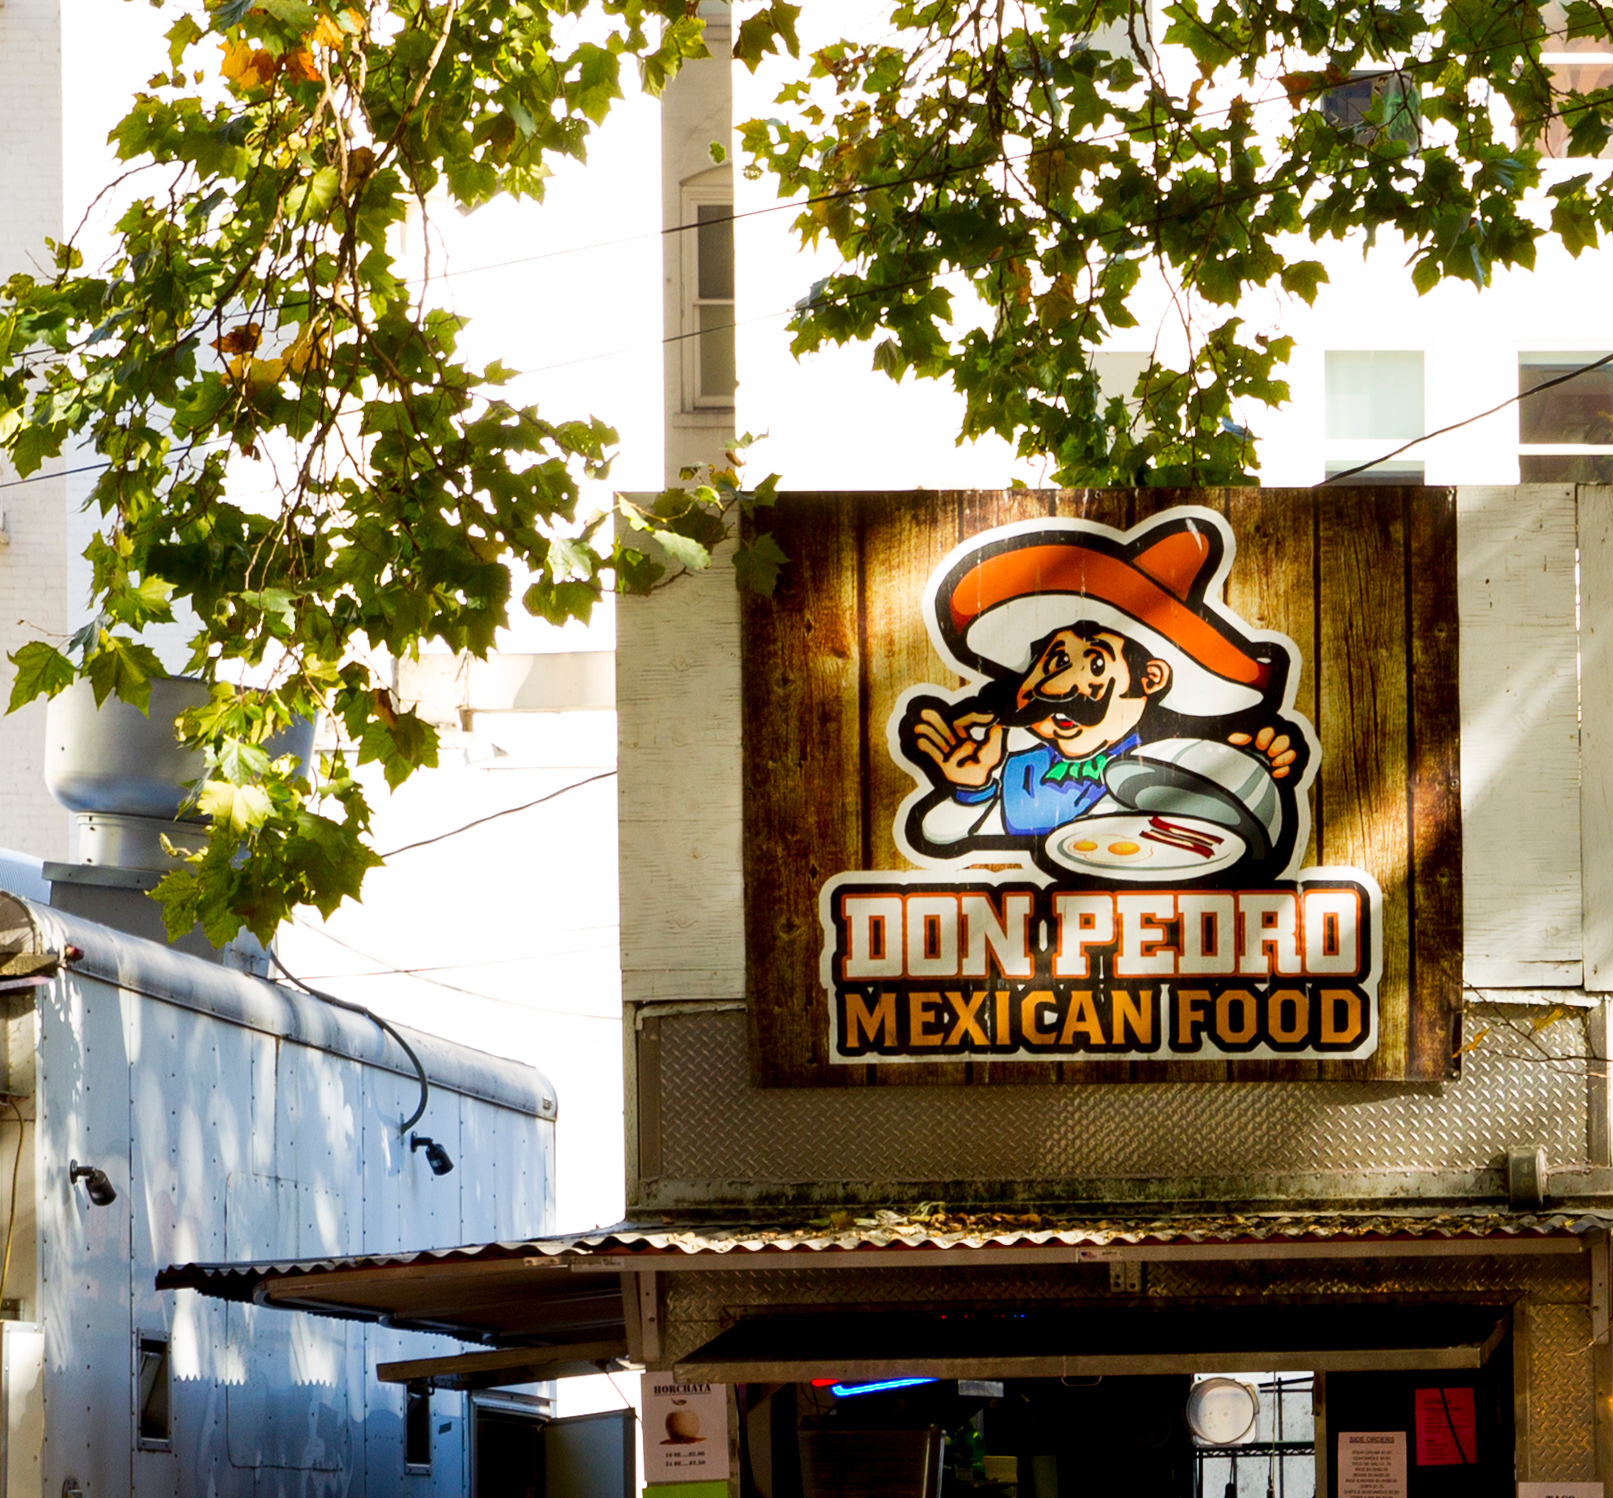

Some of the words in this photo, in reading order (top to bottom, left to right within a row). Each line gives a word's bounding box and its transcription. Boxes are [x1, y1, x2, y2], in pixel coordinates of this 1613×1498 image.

[842, 891, 1031, 980] DON
[1053, 890, 1362, 977] PEDRO
[846, 988, 1153, 1051] MEXICAN
[1177, 988, 1362, 1047] FOOD
[654, 1383, 712, 1395] HORCHATA
